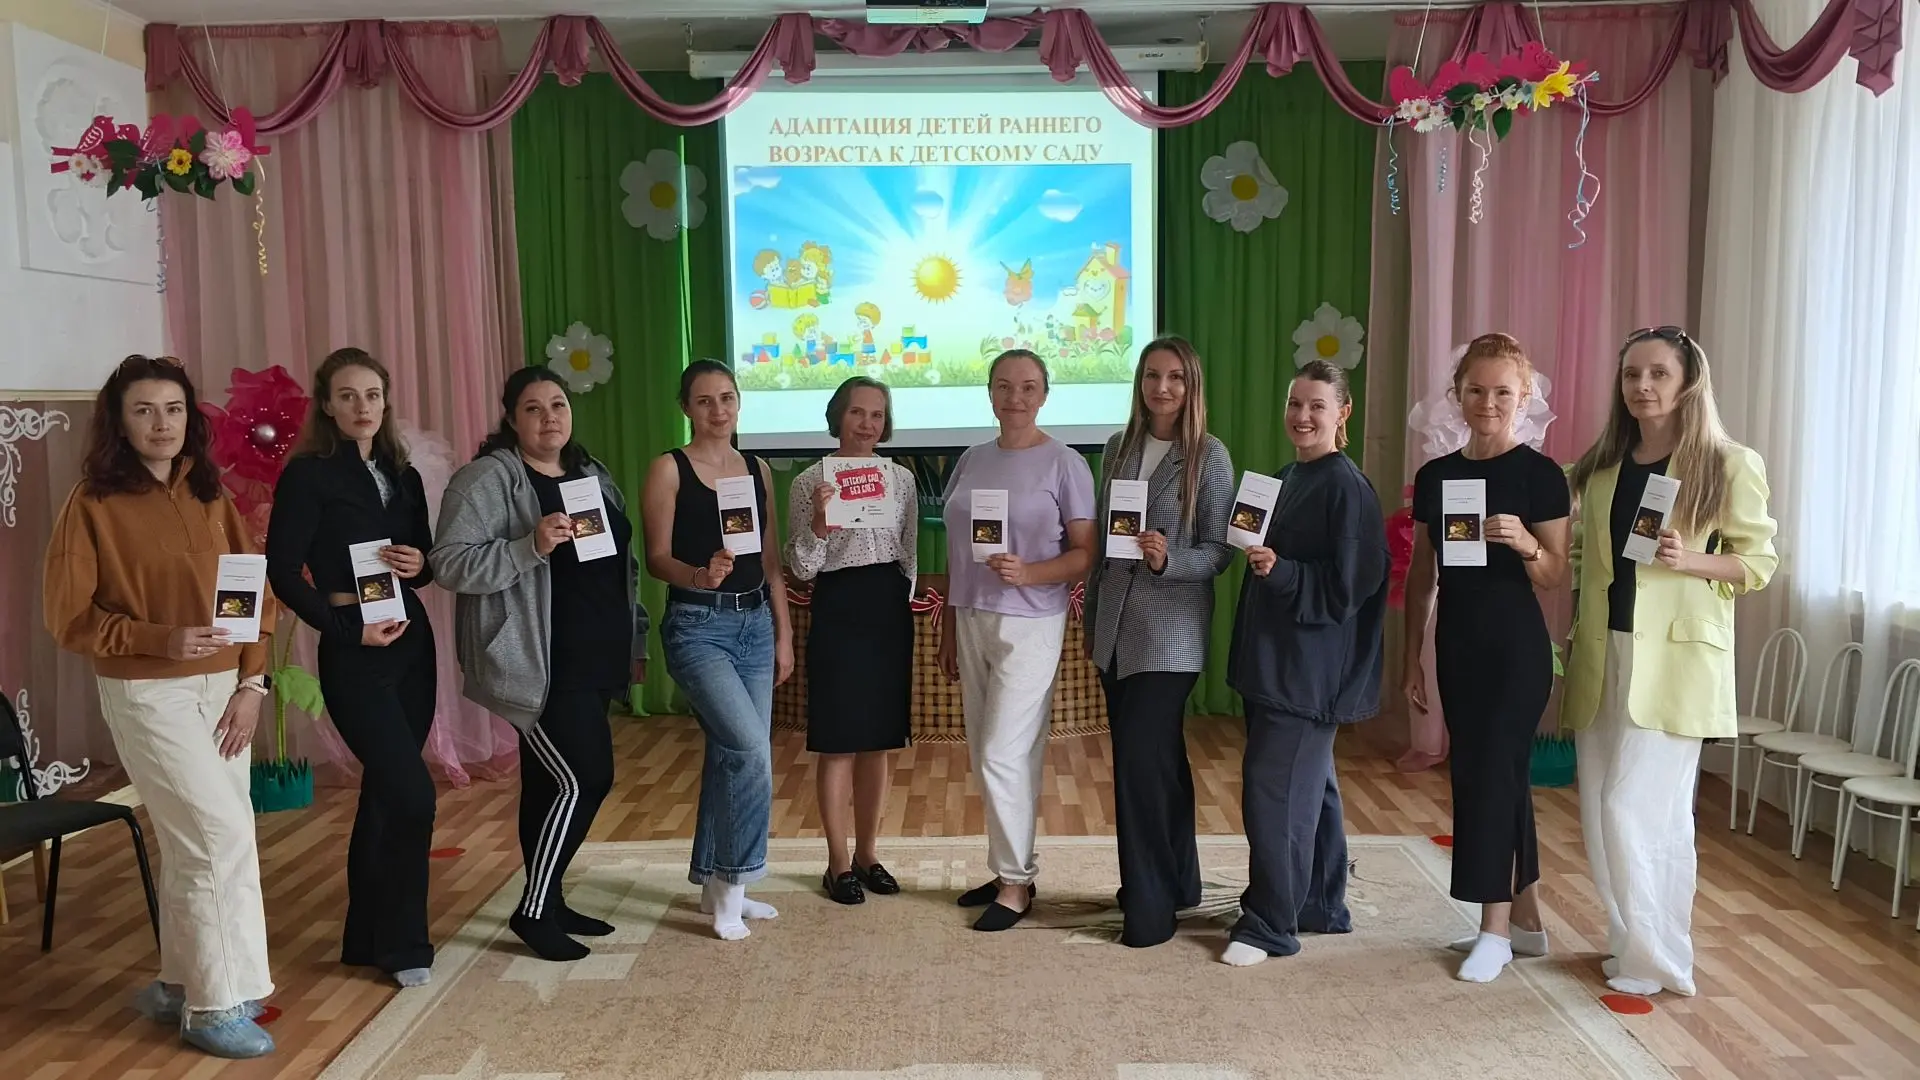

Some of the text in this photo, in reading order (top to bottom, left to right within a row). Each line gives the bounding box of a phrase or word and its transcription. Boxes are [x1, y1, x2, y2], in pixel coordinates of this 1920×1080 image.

[768, 114, 1103, 137] АДАПТАЦИЯ ДЕТЕЙ РАННЕГО
[768, 143, 1104, 165] ВОЗРАСТА К ДЕТСКОМУ САДУ
